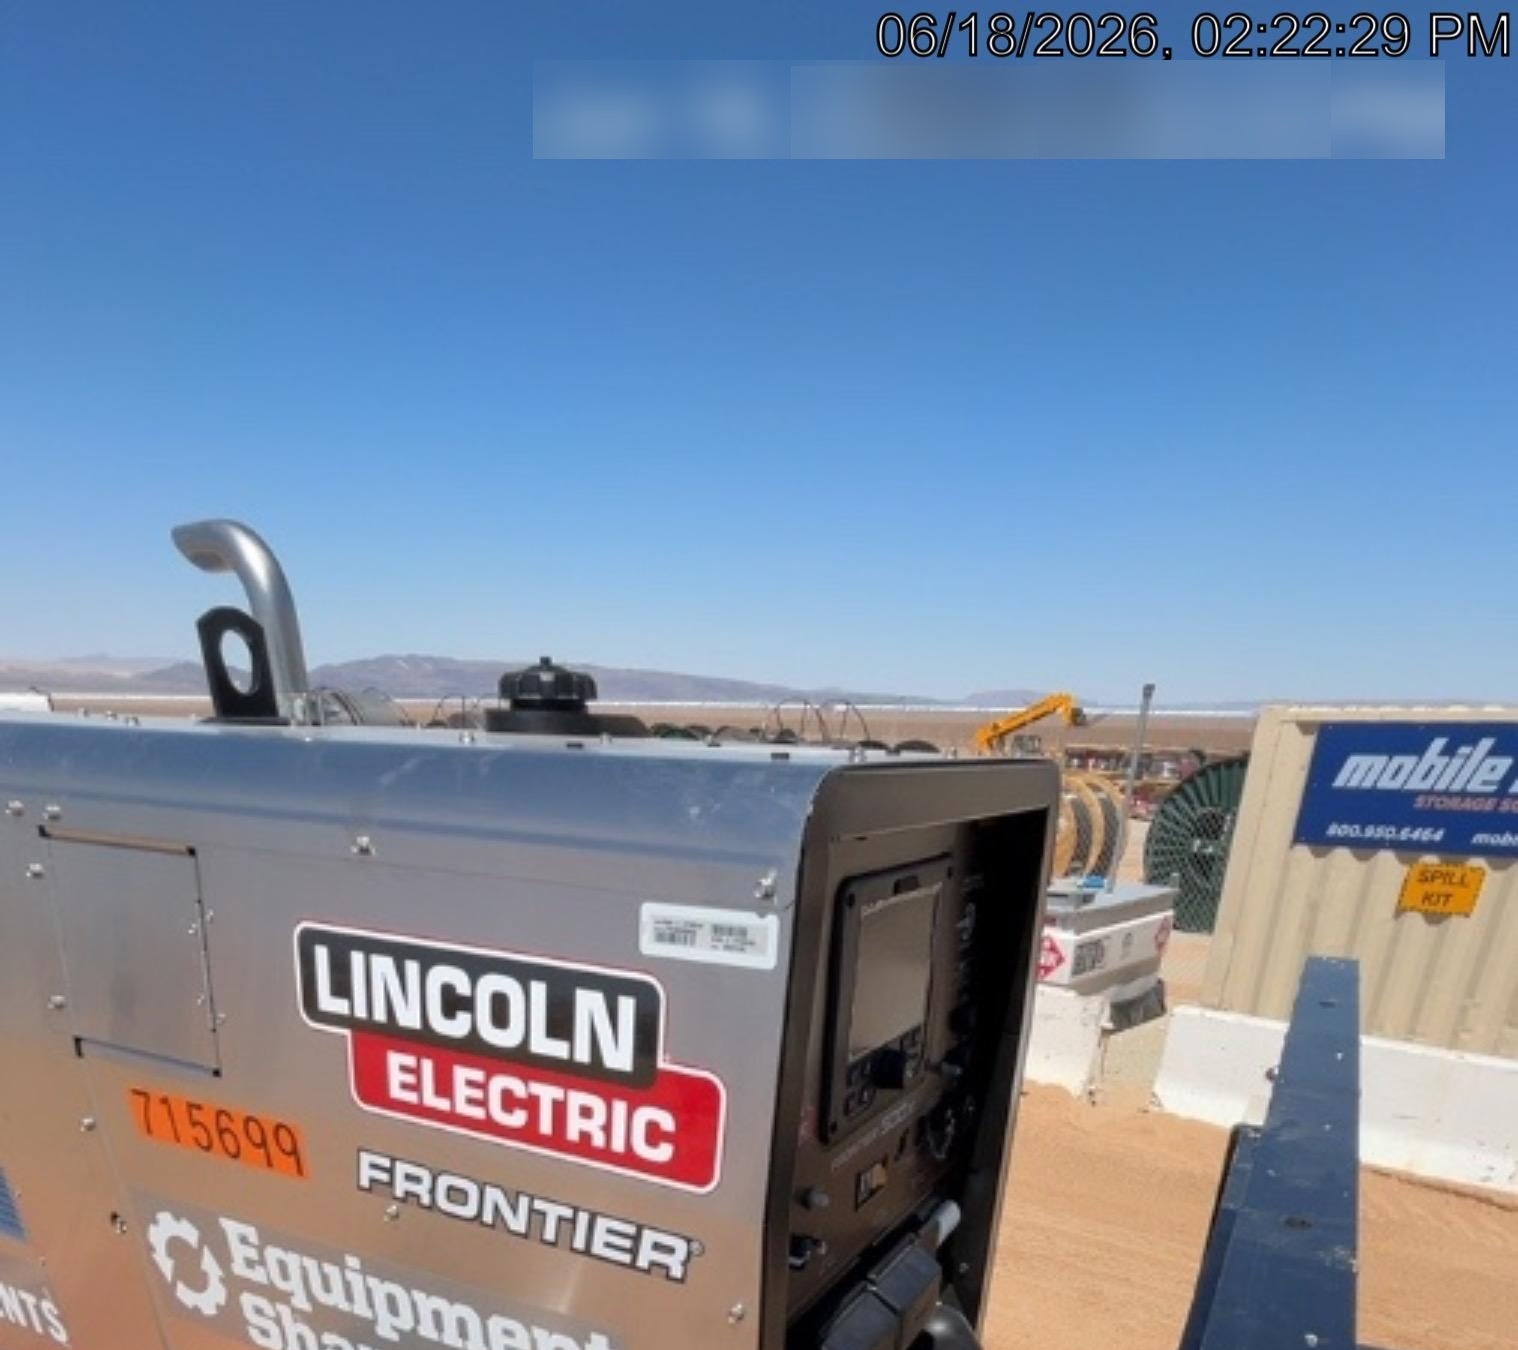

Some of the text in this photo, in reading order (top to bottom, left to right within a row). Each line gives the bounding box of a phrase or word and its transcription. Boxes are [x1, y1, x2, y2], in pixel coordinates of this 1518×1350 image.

[1331, 737, 1514, 792] mobile
[1418, 868, 1469, 886] SPILL
[1421, 892, 1454, 908] KIT
[313, 944, 635, 1073] LINCOLN
[131, 1088, 305, 1178] 715699
[386, 1050, 676, 1163] ELECTRIC
[0, 1282, 69, 1345] NTS
